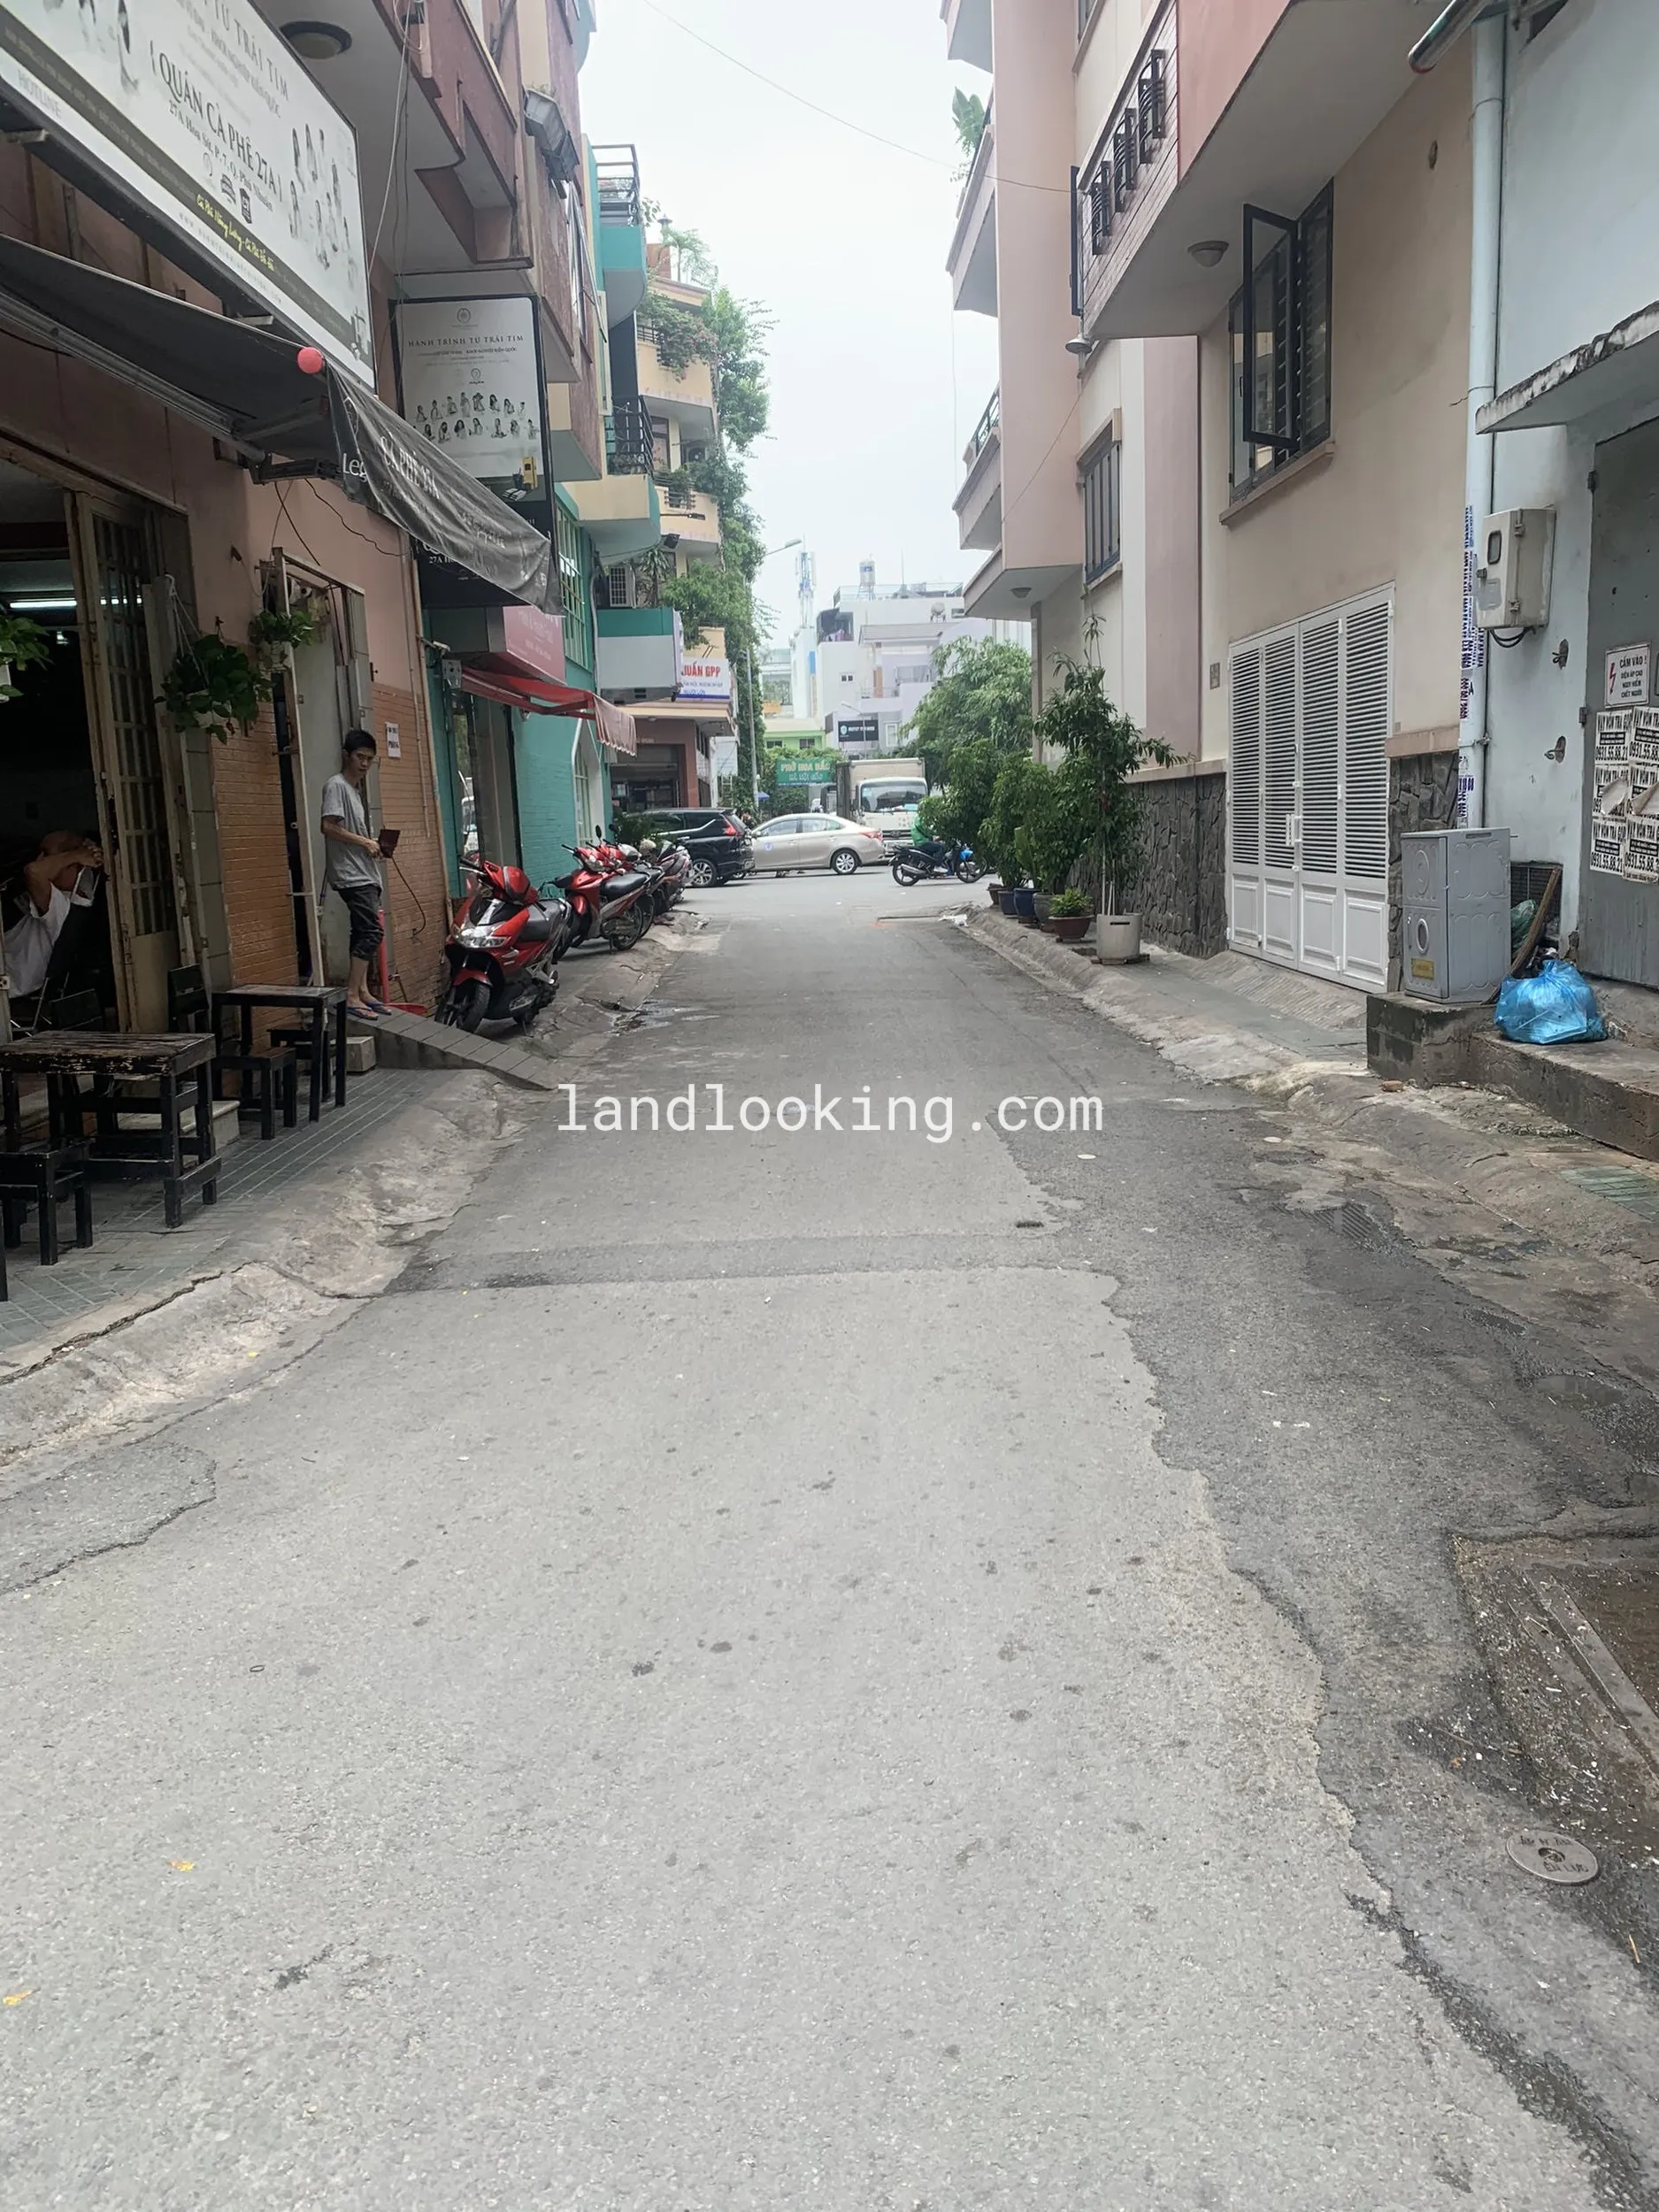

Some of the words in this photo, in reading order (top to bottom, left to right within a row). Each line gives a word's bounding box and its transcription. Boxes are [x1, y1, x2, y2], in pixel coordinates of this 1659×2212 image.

[159, 53, 204, 119] QUÁN
[206, 103, 227, 143] CÀ
[228, 123, 254, 172] PHÊ
[255, 151, 277, 195] 27A
[507, 334, 524, 343] TIM
[705, 665, 721, 678] GPP
